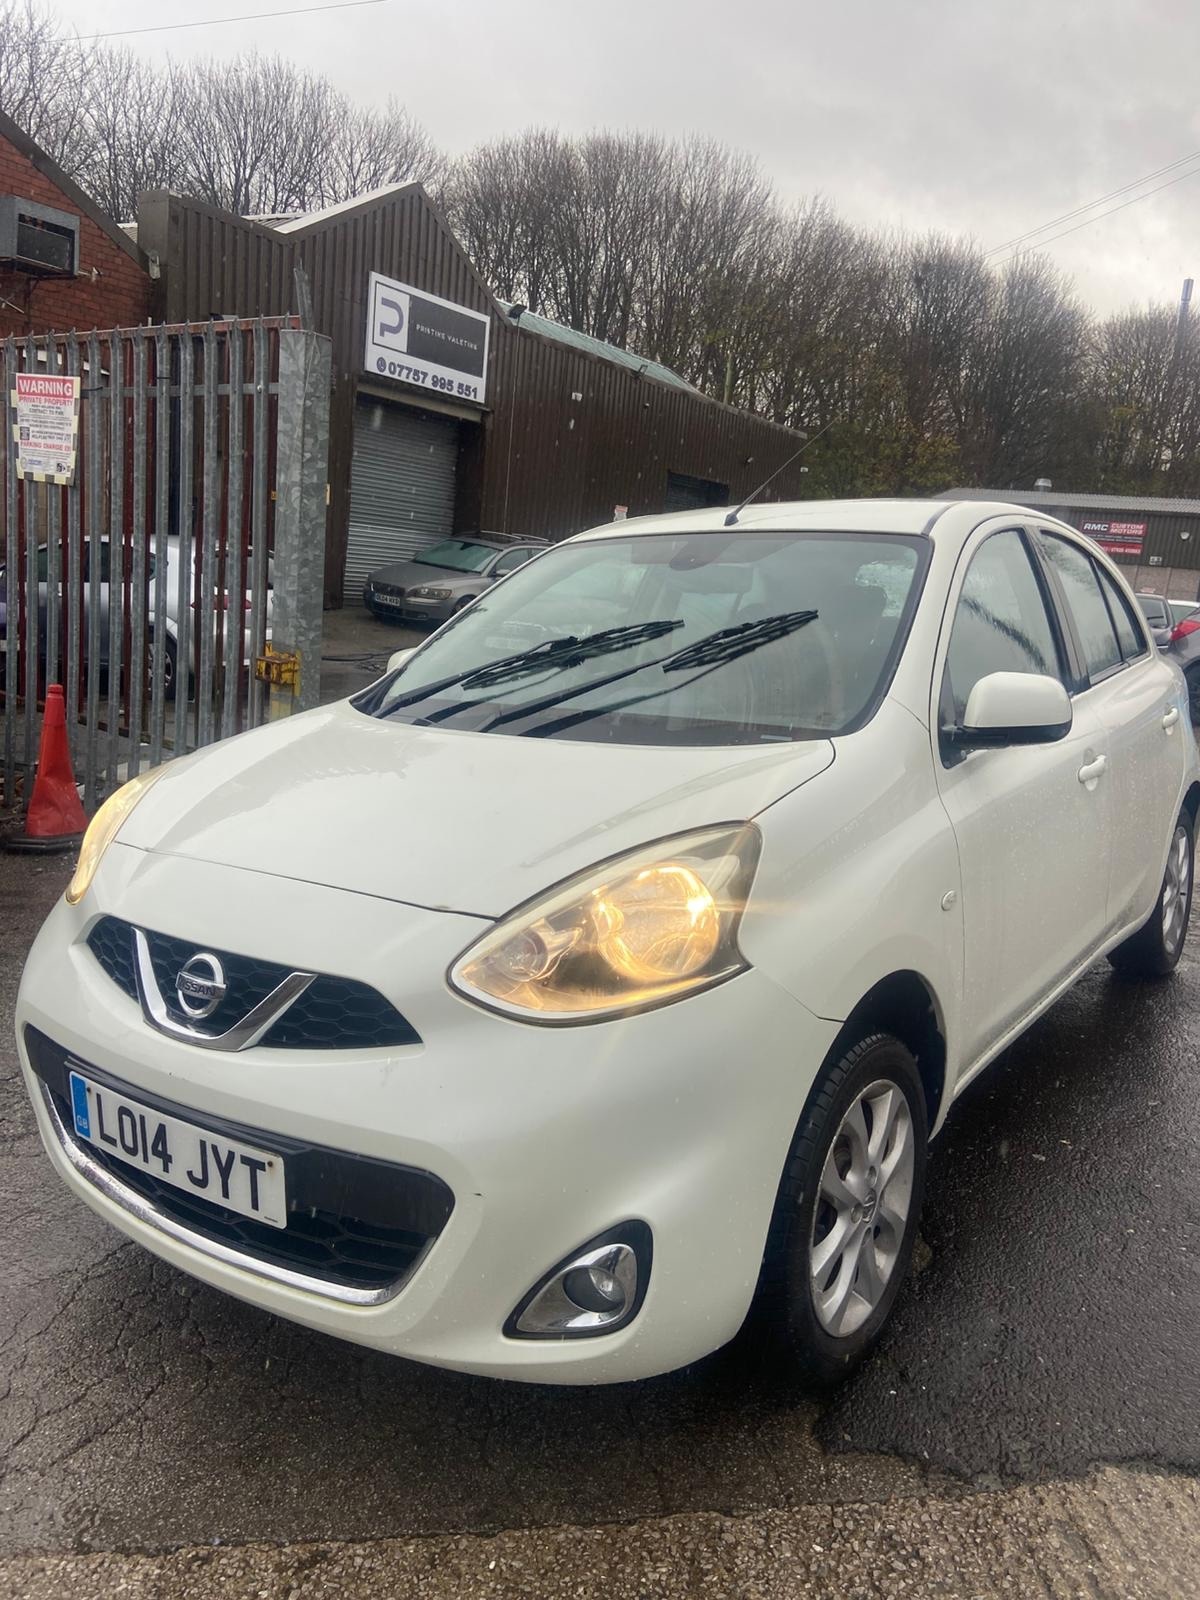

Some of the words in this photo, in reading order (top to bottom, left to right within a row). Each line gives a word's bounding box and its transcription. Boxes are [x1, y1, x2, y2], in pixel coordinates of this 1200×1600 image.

[416, 323, 446, 340] PRISTINE
[19, 379, 73, 396] WARNING
[388, 361, 428, 384] 07757
[431, 374, 454, 392] 995
[457, 382, 478, 399] 551
[19, 396, 42, 405] PRIVATE
[44, 398, 73, 407] PROPERTY
[20, 440, 42, 449] PARKING
[1083, 523, 1109, 531] AMC
[179, 974, 217, 997] NISSAN
[76, 1114, 89, 1129] GB
[186, 1138, 267, 1212] JYT
